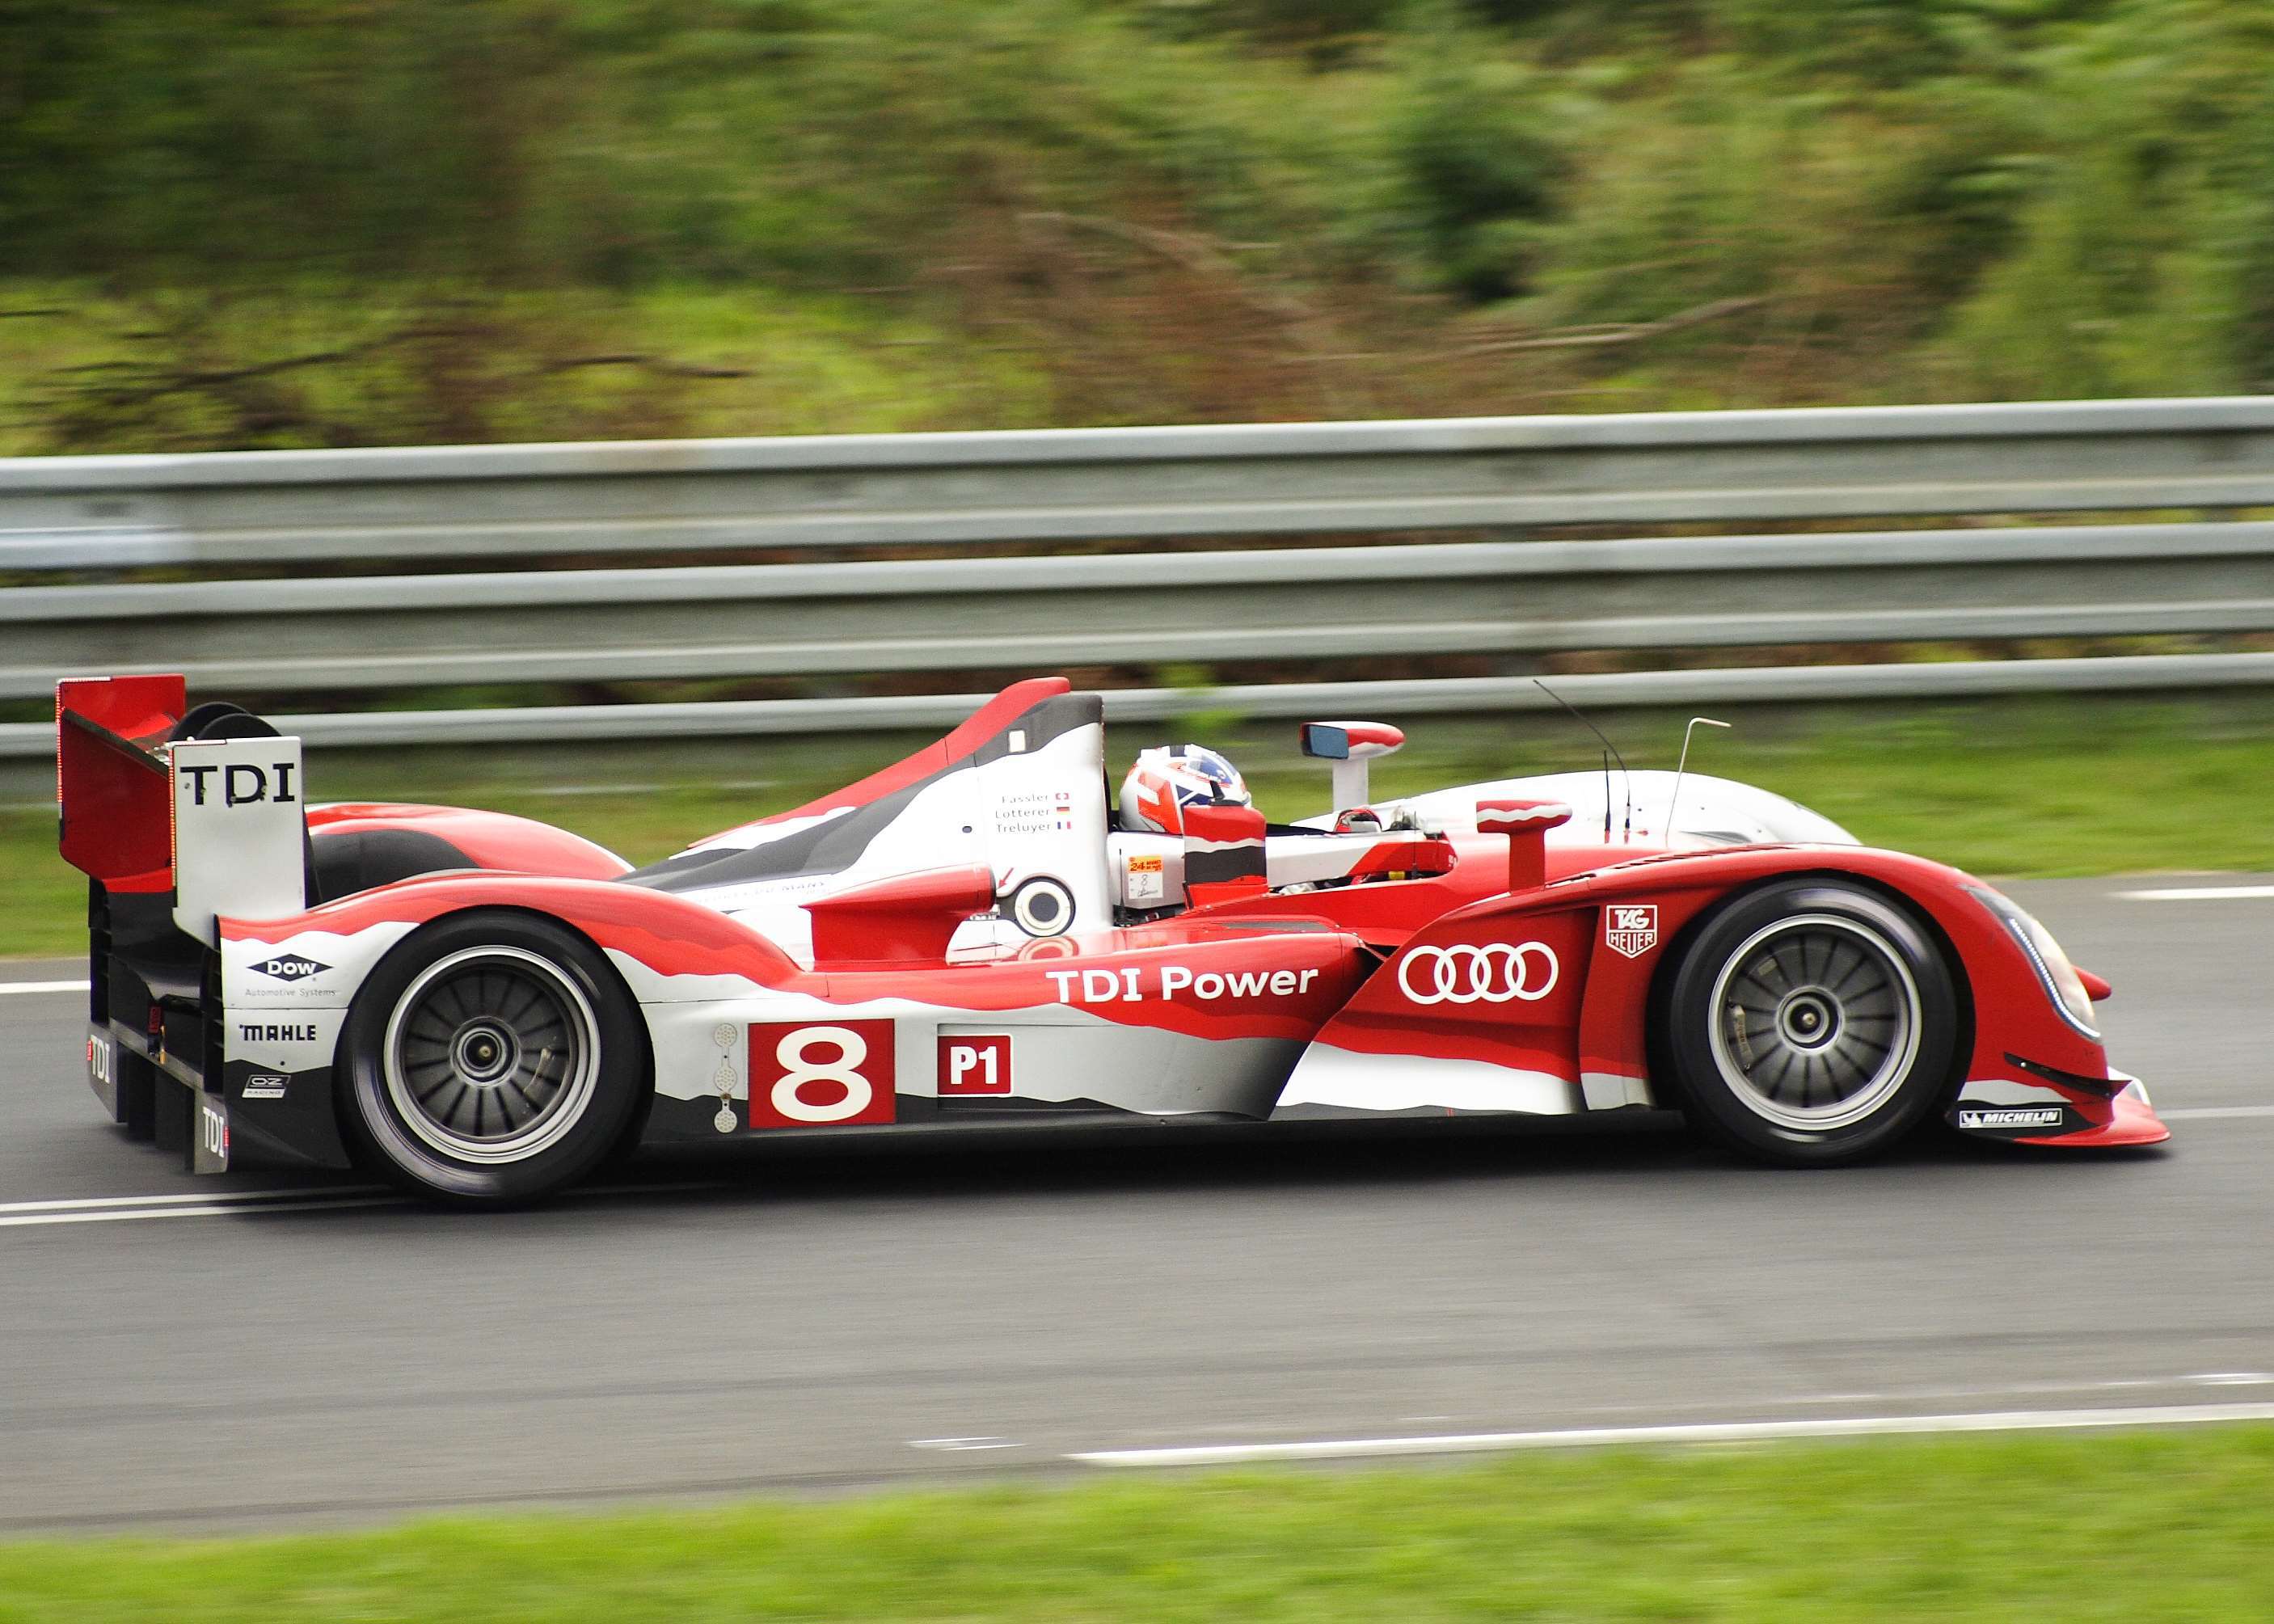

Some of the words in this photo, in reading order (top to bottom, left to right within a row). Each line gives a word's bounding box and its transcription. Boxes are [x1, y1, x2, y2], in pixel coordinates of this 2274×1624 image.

[180, 763, 295, 808] TDI
[995, 808, 1049, 819] Lotterer
[996, 822, 1051, 833] Treluyer
[1614, 909, 1650, 930] TAG
[1610, 933, 1654, 954] HEUER
[245, 988, 296, 997] Automotive
[299, 988, 336, 998] Systems
[1045, 968, 1143, 1004] TDI
[1160, 965, 1319, 1001] Power
[239, 1023, 317, 1041] MAHLE
[90, 1034, 111, 1084] TDI
[950, 1045, 998, 1085] P1
[251, 1077, 284, 1086] OZ
[770, 1026, 872, 1122] 8
[1983, 1111, 2059, 1124] MICHELIN
[202, 1106, 225, 1158] TDI
